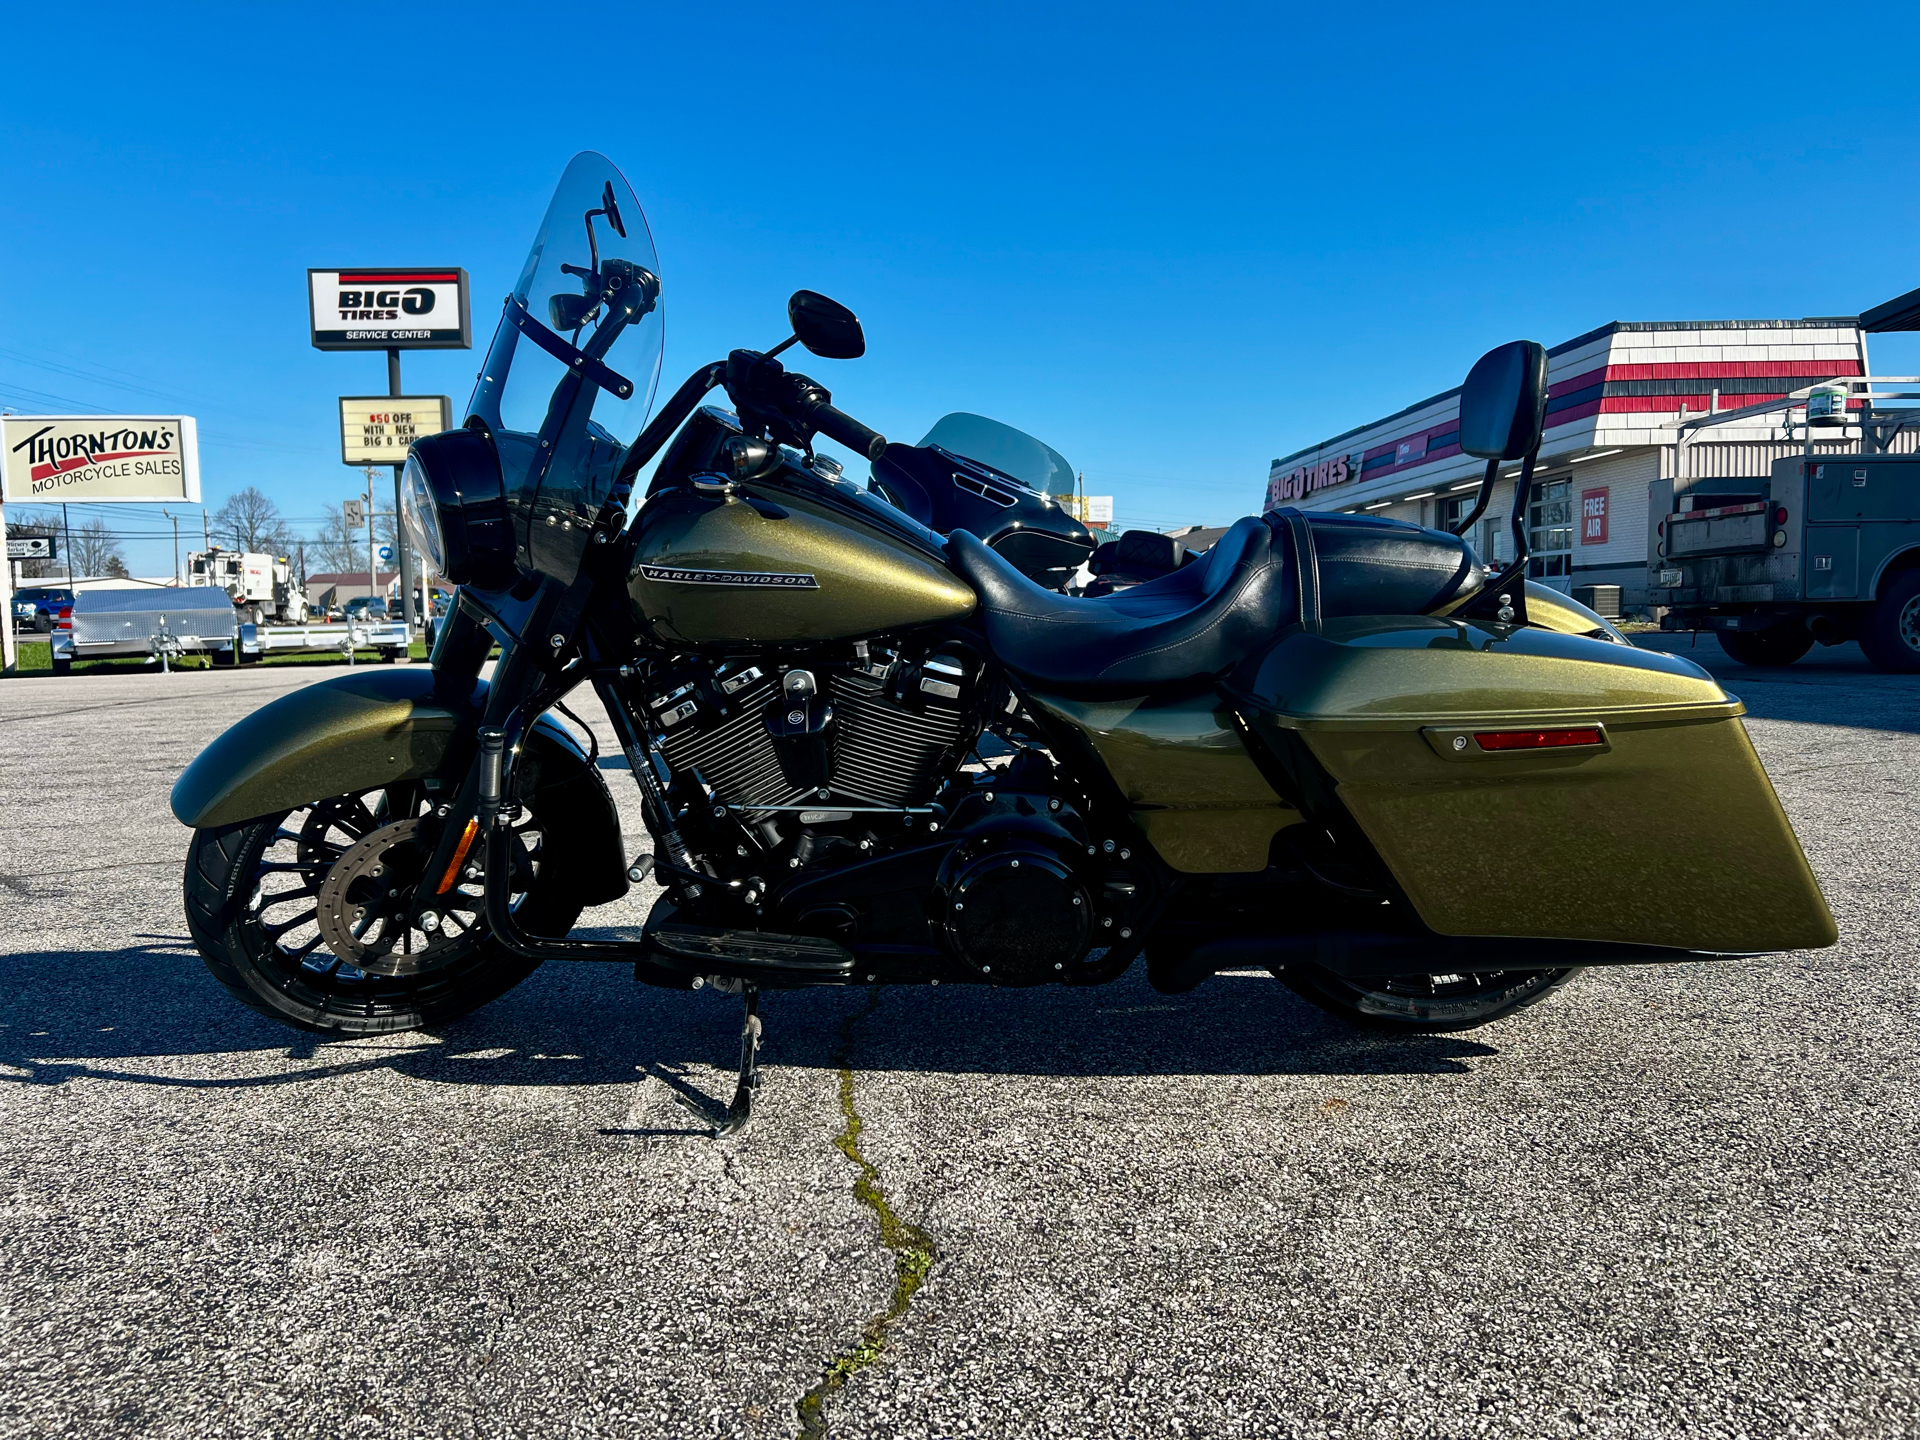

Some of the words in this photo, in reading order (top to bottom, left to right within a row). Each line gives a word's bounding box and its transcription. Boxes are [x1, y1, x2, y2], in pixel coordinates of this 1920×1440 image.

[338, 291, 401, 308] BIG
[401, 287, 436, 315] O
[339, 310, 398, 321] TIRES
[346, 330, 388, 340] SERVICE
[391, 330, 432, 339] CENTER
[369, 413, 390, 424] $50
[392, 413, 412, 424] OFF
[363, 424, 385, 435] WITH
[395, 424, 416, 435] NEW
[12, 425, 174, 470] THORNTON'S
[363, 436, 382, 447] BIG
[32, 462, 131, 495] MOTORCYCLE
[134, 459, 181, 476] SALES
[1271, 473, 1294, 502] BIG
[1305, 454, 1350, 493] TIRES
[1584, 496, 1605, 517] FREE
[1586, 518, 1602, 538] AIR
[648, 569, 811, 585] HARLEY-DAVIDSON
